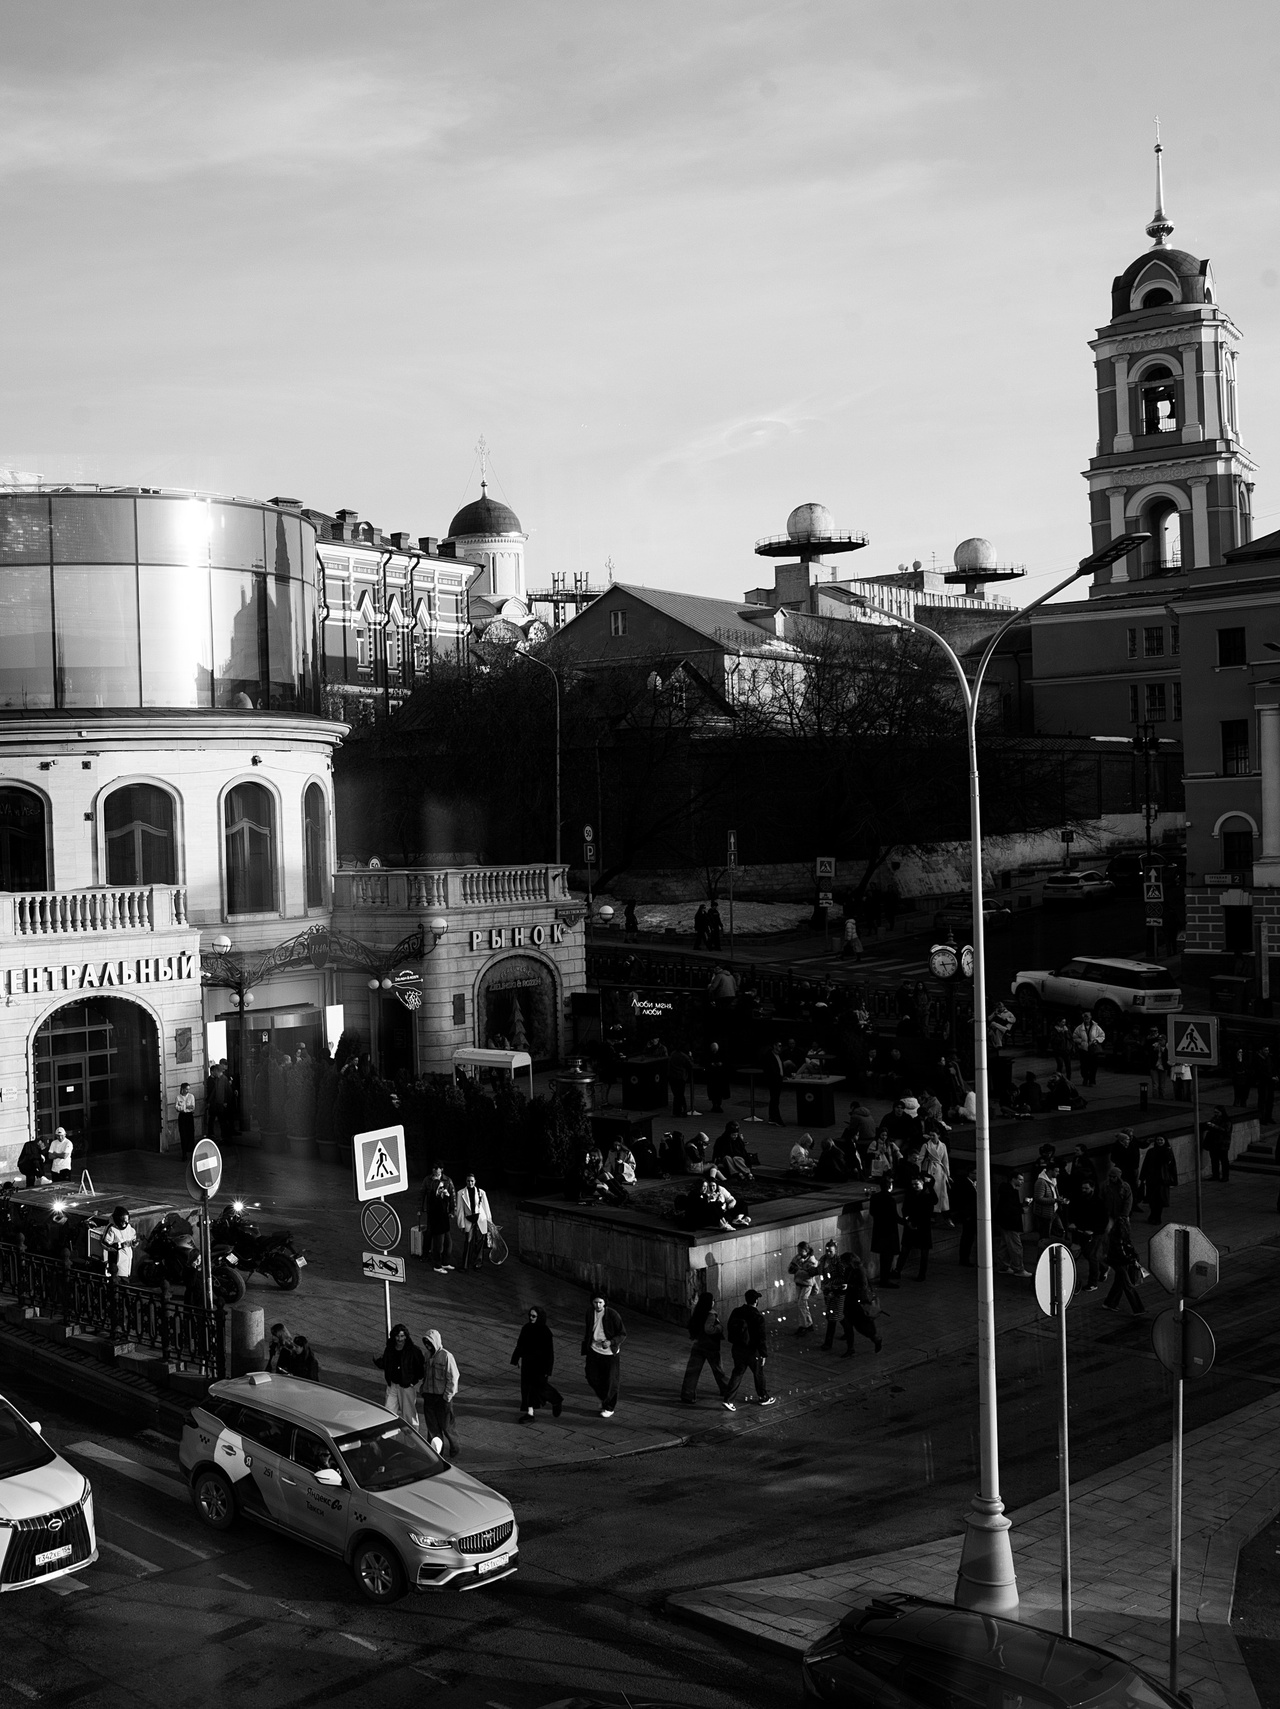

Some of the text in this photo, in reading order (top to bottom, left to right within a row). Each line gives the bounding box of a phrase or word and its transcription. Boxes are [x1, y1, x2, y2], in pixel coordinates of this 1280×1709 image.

[586, 829, 592, 838] 50
[587, 846, 594, 860] P
[470, 924, 564, 951] РЫНОК
[631, 999, 653, 1008] Люби
[642, 1008, 662, 1016] люби
[246, 1456, 252, 1467] Я
[263, 1466, 273, 1479] 251
[306, 1487, 343, 1511] Яндекс Go
[306, 1500, 325, 1517] Такси
